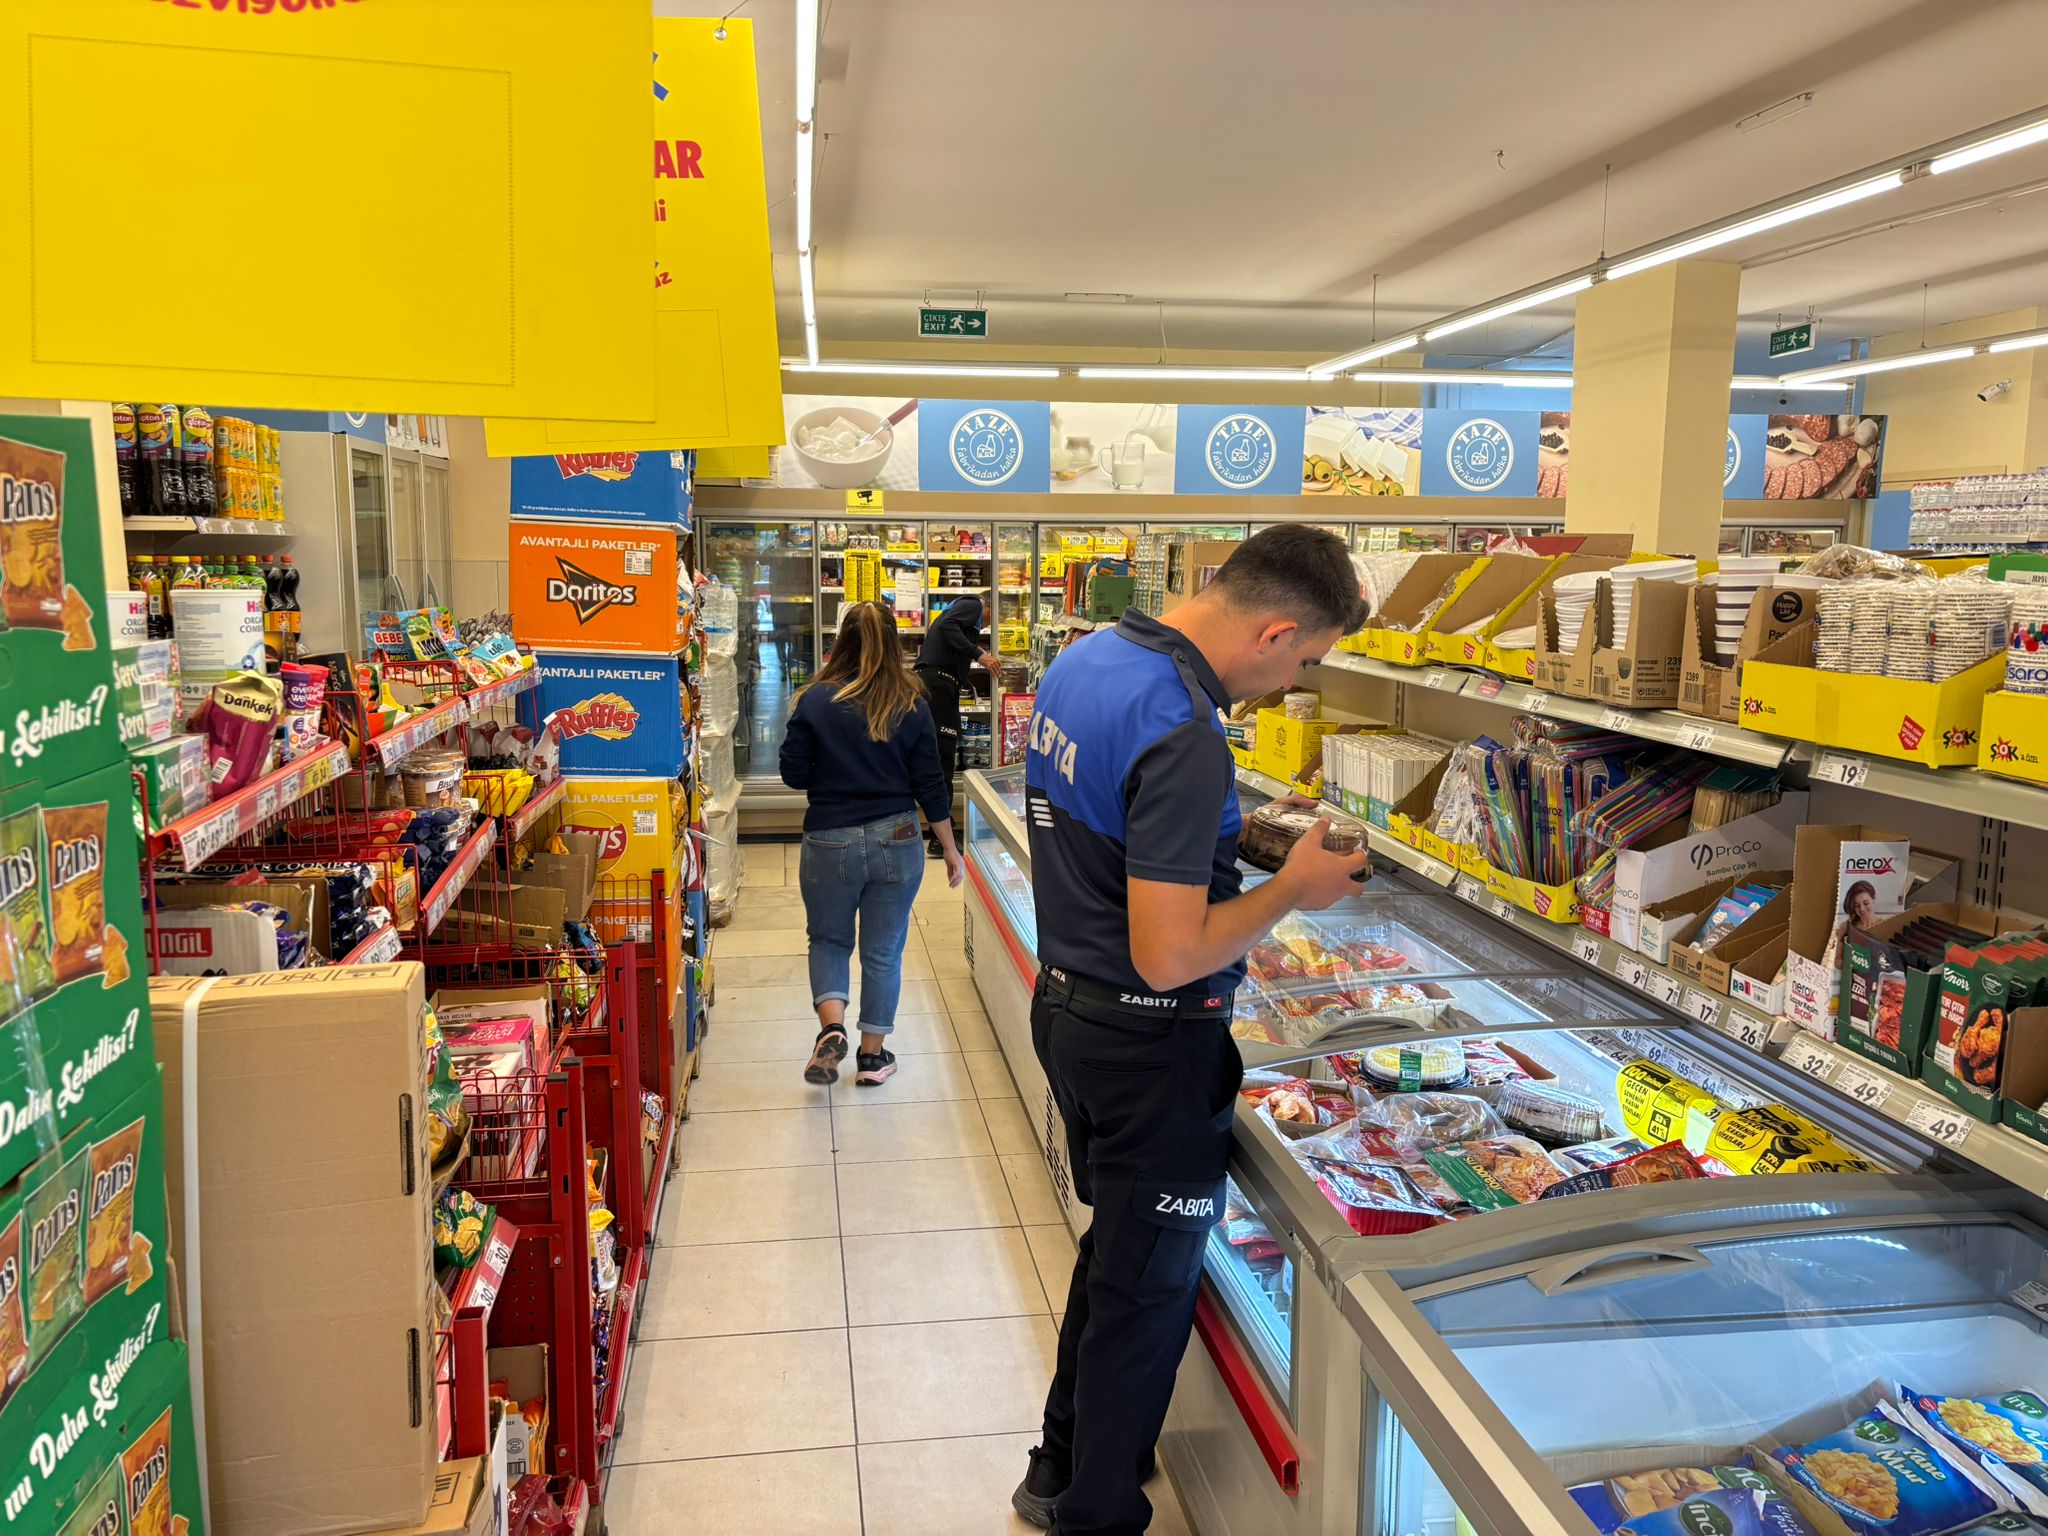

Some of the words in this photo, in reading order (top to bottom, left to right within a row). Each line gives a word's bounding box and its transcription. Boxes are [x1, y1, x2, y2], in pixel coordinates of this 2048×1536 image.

[654, 140, 705, 179] AR
[924, 323, 946, 331] EXIT
[113, 415, 133, 423] pton
[960, 414, 1012, 437] TAZE
[1217, 420, 1264, 442] TAZE
[1457, 424, 1504, 445] TAZE
[956, 446, 1001, 480] fabrikadan
[999, 446, 1017, 474] halka
[1212, 451, 1253, 483] fabrikadan
[1252, 451, 1271, 478] halka
[1453, 454, 1492, 485] fabrikadan
[1490, 454, 1509, 480] halka
[520, 535, 589, 549] AVANTAJLI
[547, 577, 638, 605] Doritos
[374, 632, 404, 644] BEBE
[536, 667, 594, 679] VANTAJLI
[2008, 667, 2048, 681] saro
[224, 692, 275, 716] Dankek
[556, 702, 641, 740] Ruffles
[1612, 716, 1625, 731] 14
[1689, 733, 1705, 749] 14
[1841, 764, 1858, 784] 19
[1716, 840, 1762, 859] ProCo
[1706, 866, 1732, 877] Bambu
[1846, 857, 1894, 870] nerox
[1468, 888, 1476, 901] 12
[1501, 905, 1511, 919] 31
[1583, 945, 1595, 961] 19
[1633, 970, 1641, 985] 9
[1666, 987, 1674, 1001] 7
[1700, 1004, 1713, 1022] 17
[1740, 1025, 1757, 1046] 26
[1648, 1046, 1662, 1062] 69
[1677, 1061, 1690, 1076] 155
[1803, 1054, 1824, 1076] 32
[1626, 1079, 1649, 1096] GEÇEN
[1853, 1082, 1879, 1102] 49
[1929, 1119, 1958, 1141] 49
[1156, 1193, 1214, 1217] ZABITA
[29, 1404, 89, 1480] Daha
[1728, 1466, 1777, 1496] nci
